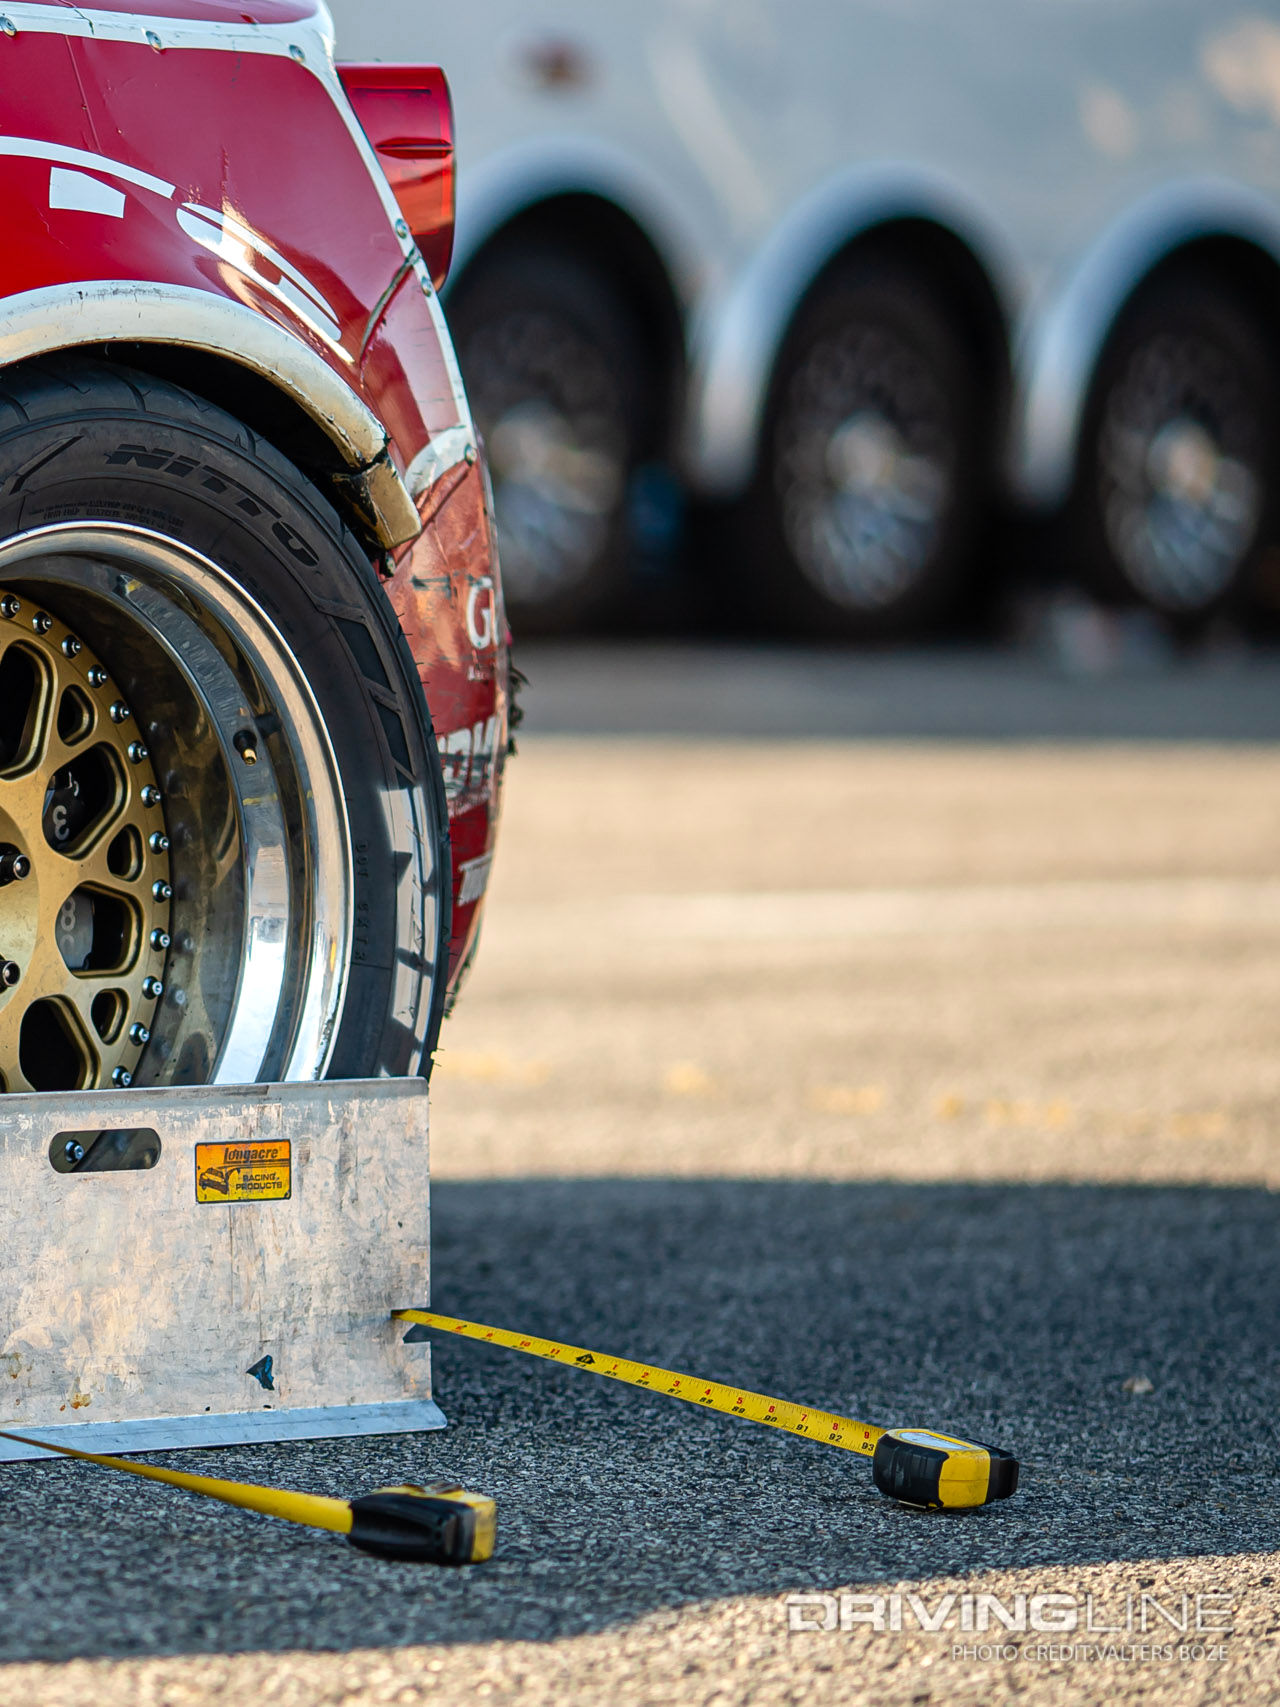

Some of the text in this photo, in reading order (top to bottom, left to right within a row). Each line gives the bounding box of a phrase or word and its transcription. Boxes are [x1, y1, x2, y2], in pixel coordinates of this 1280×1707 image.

[235, 1181, 283, 1191] PRODUCTS
[242, 1173, 276, 1182] RACING
[731, 1405, 746, 1415] 89
[763, 1414, 778, 1423] 90
[795, 1424, 809, 1433] 91
[828, 1433, 843, 1443] 92
[861, 1442, 875, 1452] 93
[736, 1397, 744, 1405] 5
[768, 1405, 776, 1413] 6
[801, 1413, 808, 1422] 7
[832, 1422, 839, 1431] 8
[863, 1431, 870, 1439] 9
